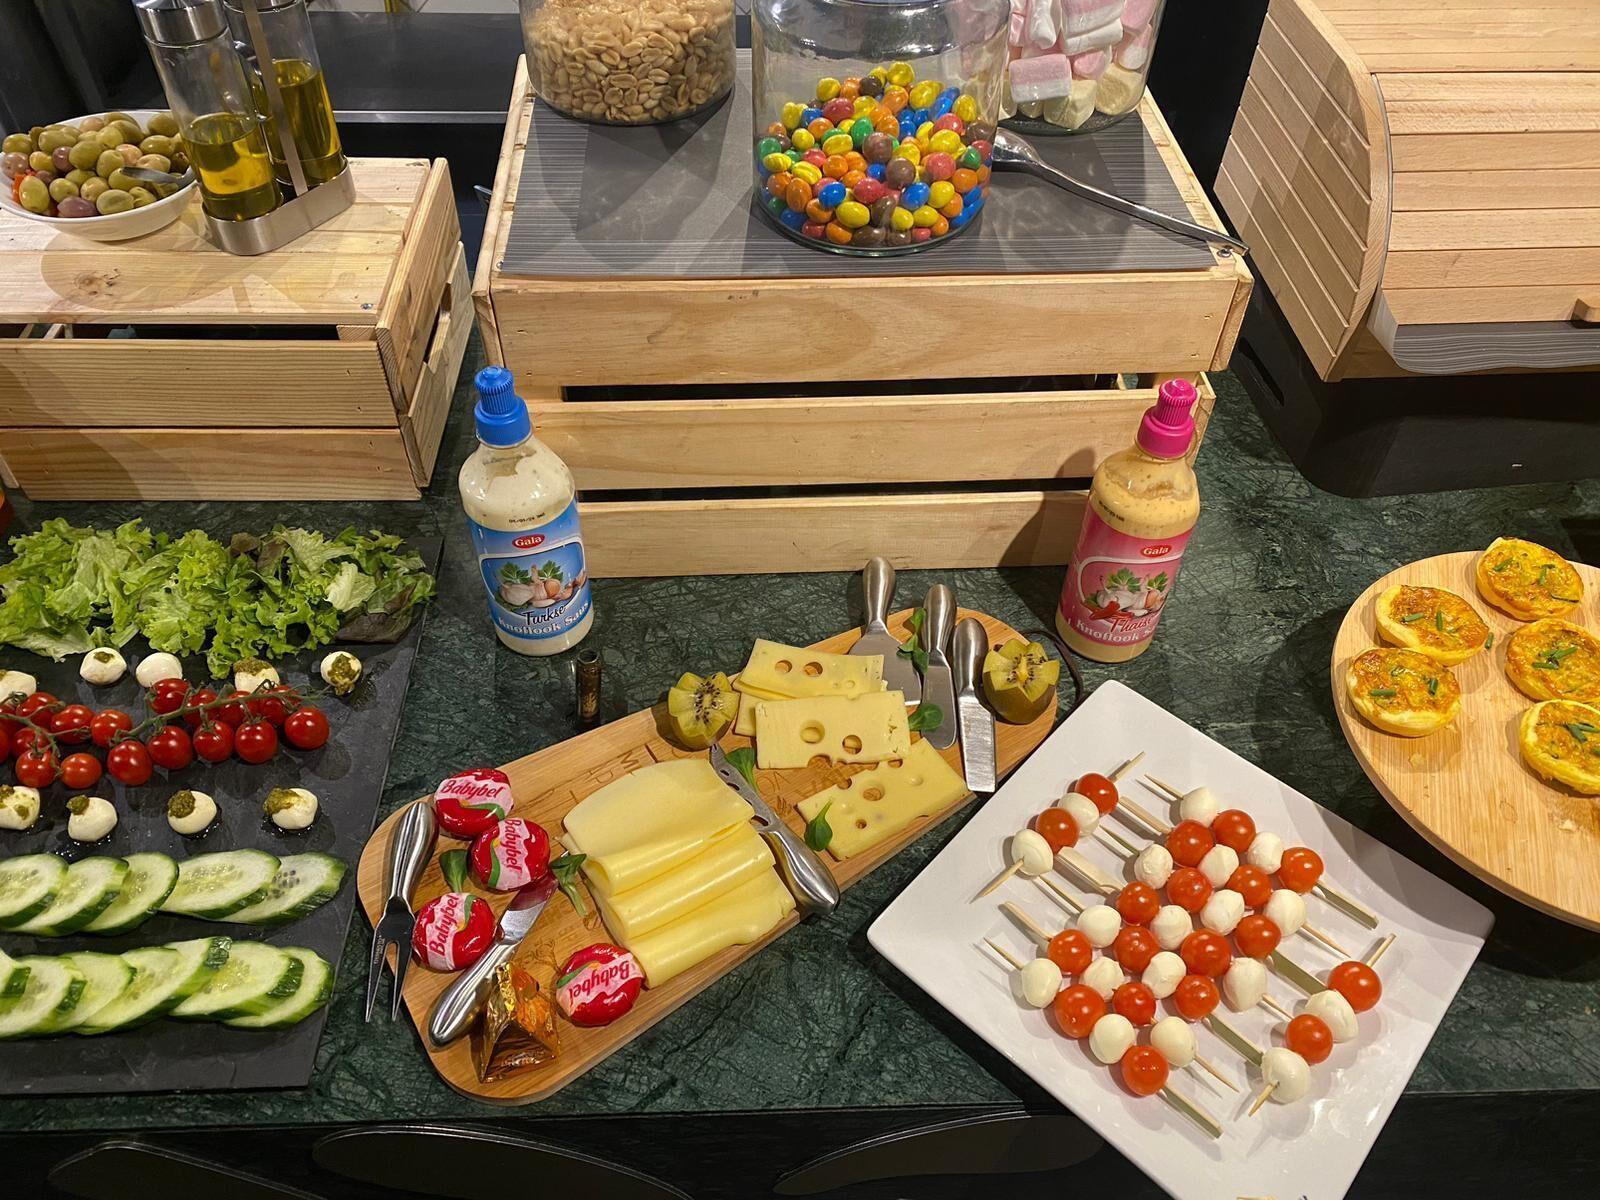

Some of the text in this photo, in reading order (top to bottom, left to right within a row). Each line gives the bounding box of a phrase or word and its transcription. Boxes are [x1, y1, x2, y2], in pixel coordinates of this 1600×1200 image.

[514, 536, 543, 547] Gala
[1143, 546, 1169, 556] Gala
[521, 605, 566, 626] Turkse
[1077, 619, 1139, 643] Knoflook
[440, 779, 506, 800] Babybel
[499, 818, 523, 874] Babybel
[429, 894, 460, 957] Babybel
[568, 960, 630, 1008] Babybel
